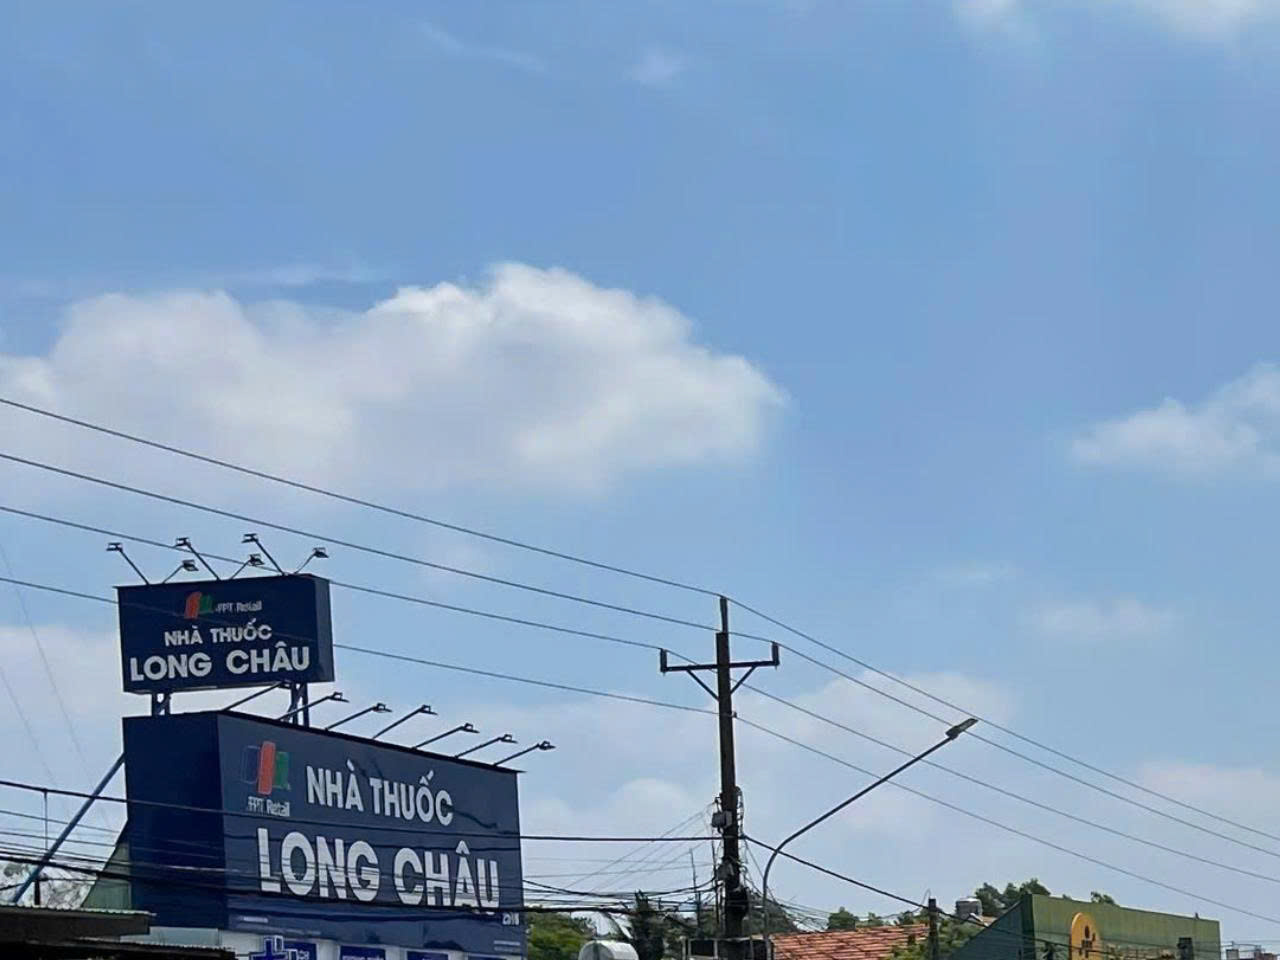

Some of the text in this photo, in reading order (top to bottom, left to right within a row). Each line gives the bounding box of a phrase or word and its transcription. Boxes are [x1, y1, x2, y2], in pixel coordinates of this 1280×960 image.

[164, 618, 273, 647] NHÀ THUỐC
[130, 641, 310, 681] LONG CHÂU
[306, 760, 453, 826] NHÀ THUỐC
[257, 827, 500, 912] LONG CHÂU
